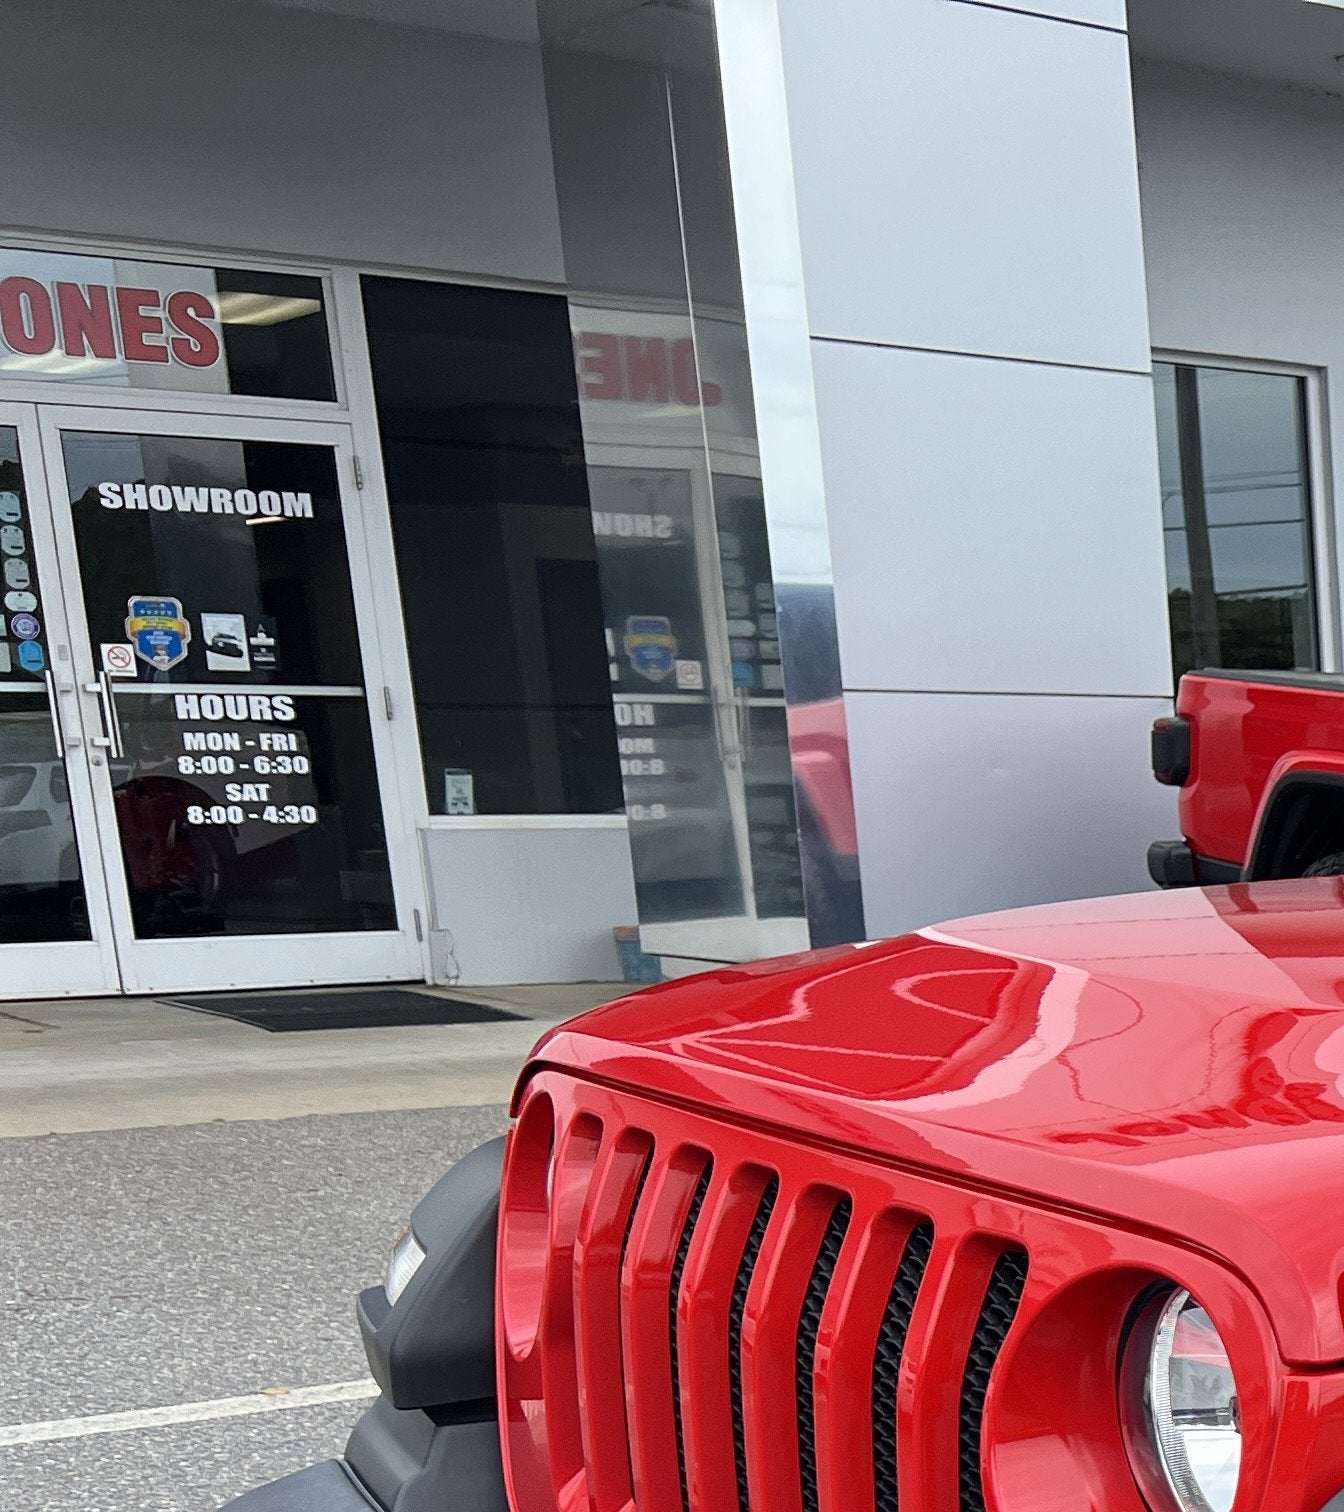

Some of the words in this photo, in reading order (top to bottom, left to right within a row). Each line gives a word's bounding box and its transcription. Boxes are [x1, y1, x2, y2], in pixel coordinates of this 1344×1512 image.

[0, 275, 220, 369] ONES
[98, 482, 315, 519] SHOWROOM
[175, 694, 297, 722] HOURS
[183, 732, 241, 752] MON
[259, 732, 298, 752] FRI
[177, 755, 235, 775] 8:00
[253, 755, 309, 775] 6:30
[225, 783, 270, 802] SAT
[187, 805, 243, 825] 8:00
[262, 805, 317, 825] 4:30
